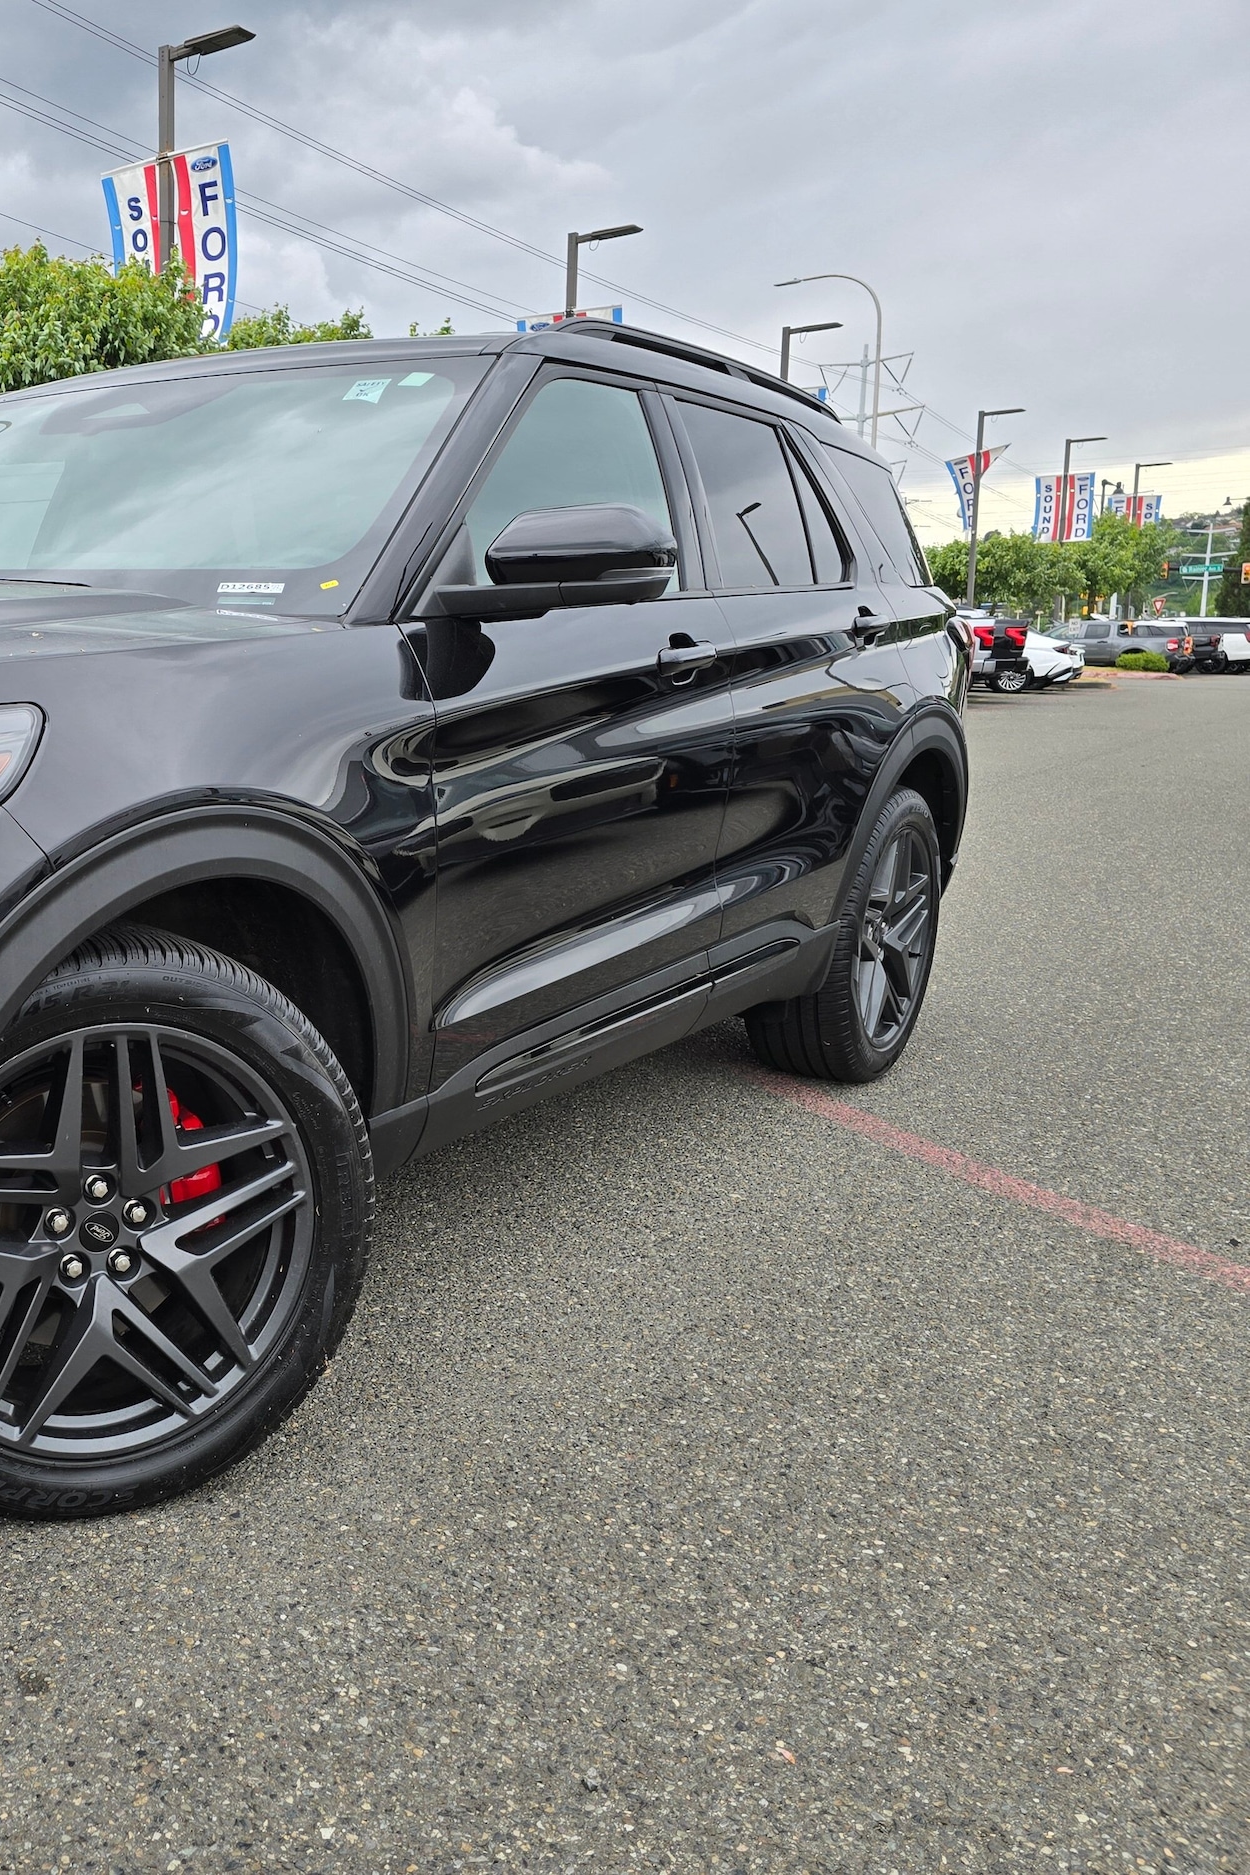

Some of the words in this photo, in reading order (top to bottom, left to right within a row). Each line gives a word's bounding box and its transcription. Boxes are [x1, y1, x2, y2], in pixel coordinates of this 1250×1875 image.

[194, 157, 214, 171] Ford
[127, 196, 149, 262] SO
[1040, 485, 1053, 534] SOUND
[1074, 484, 1089, 537] FORD
[89, 1224, 111, 1240] Ford
